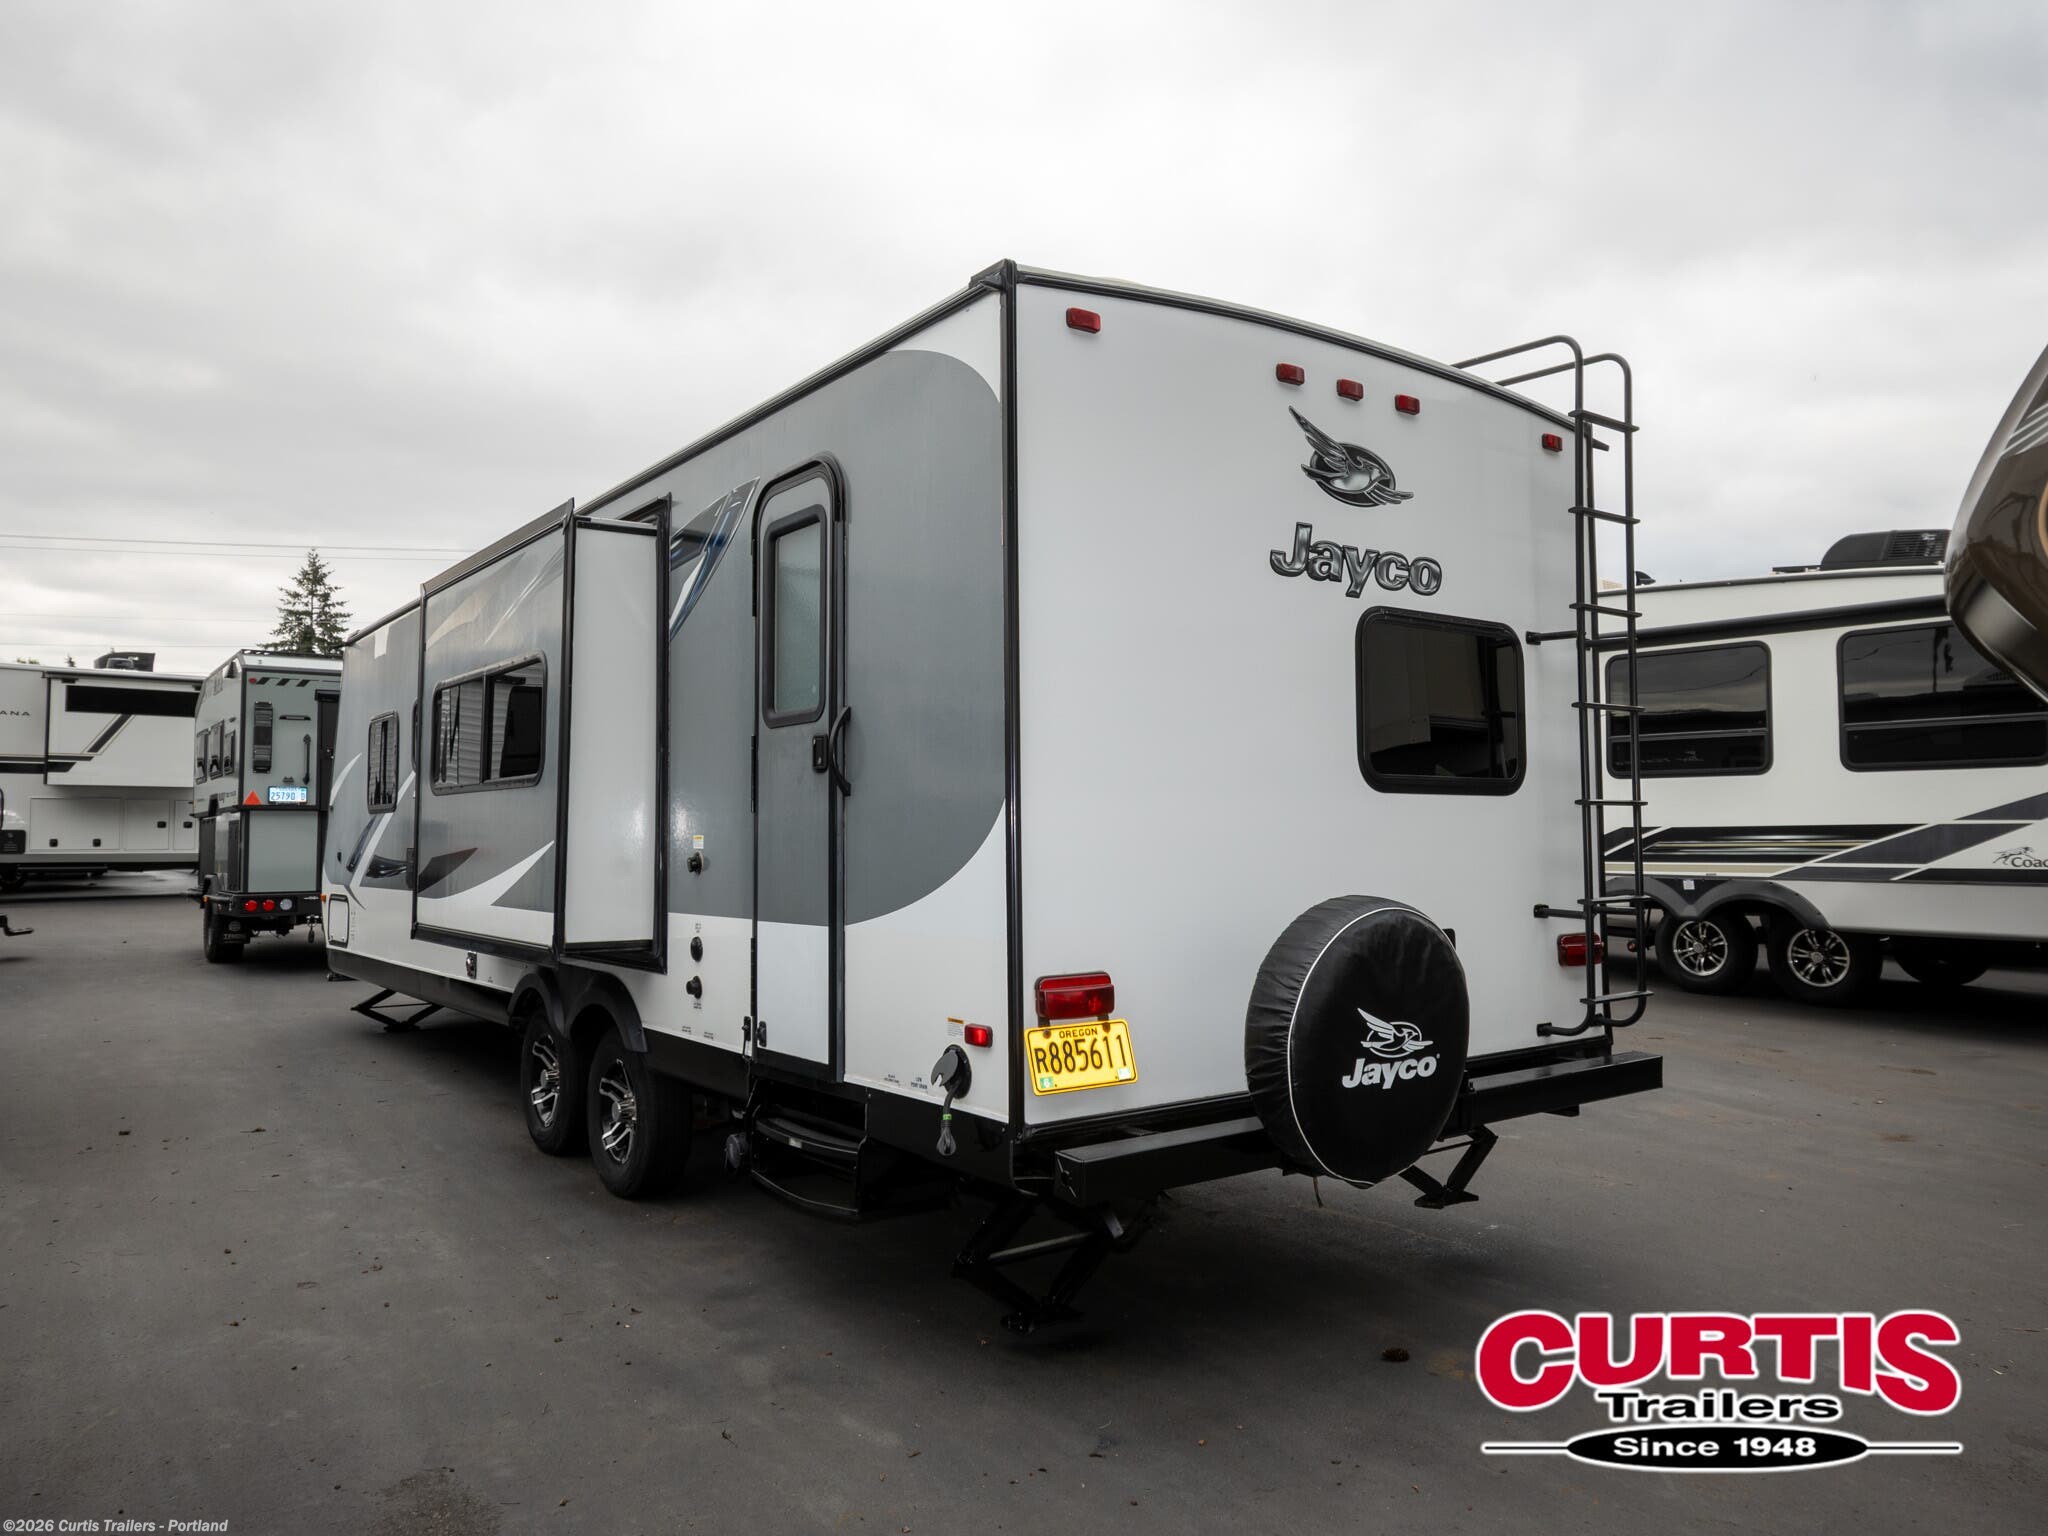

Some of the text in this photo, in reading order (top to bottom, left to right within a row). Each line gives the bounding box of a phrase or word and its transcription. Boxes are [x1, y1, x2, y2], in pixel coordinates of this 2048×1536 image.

[1269, 521, 1442, 599] Jayco
[1059, 1028, 1098, 1039] OREGON
[1034, 1034, 1127, 1074] R885611
[1341, 1054, 1437, 1090] Jayco
